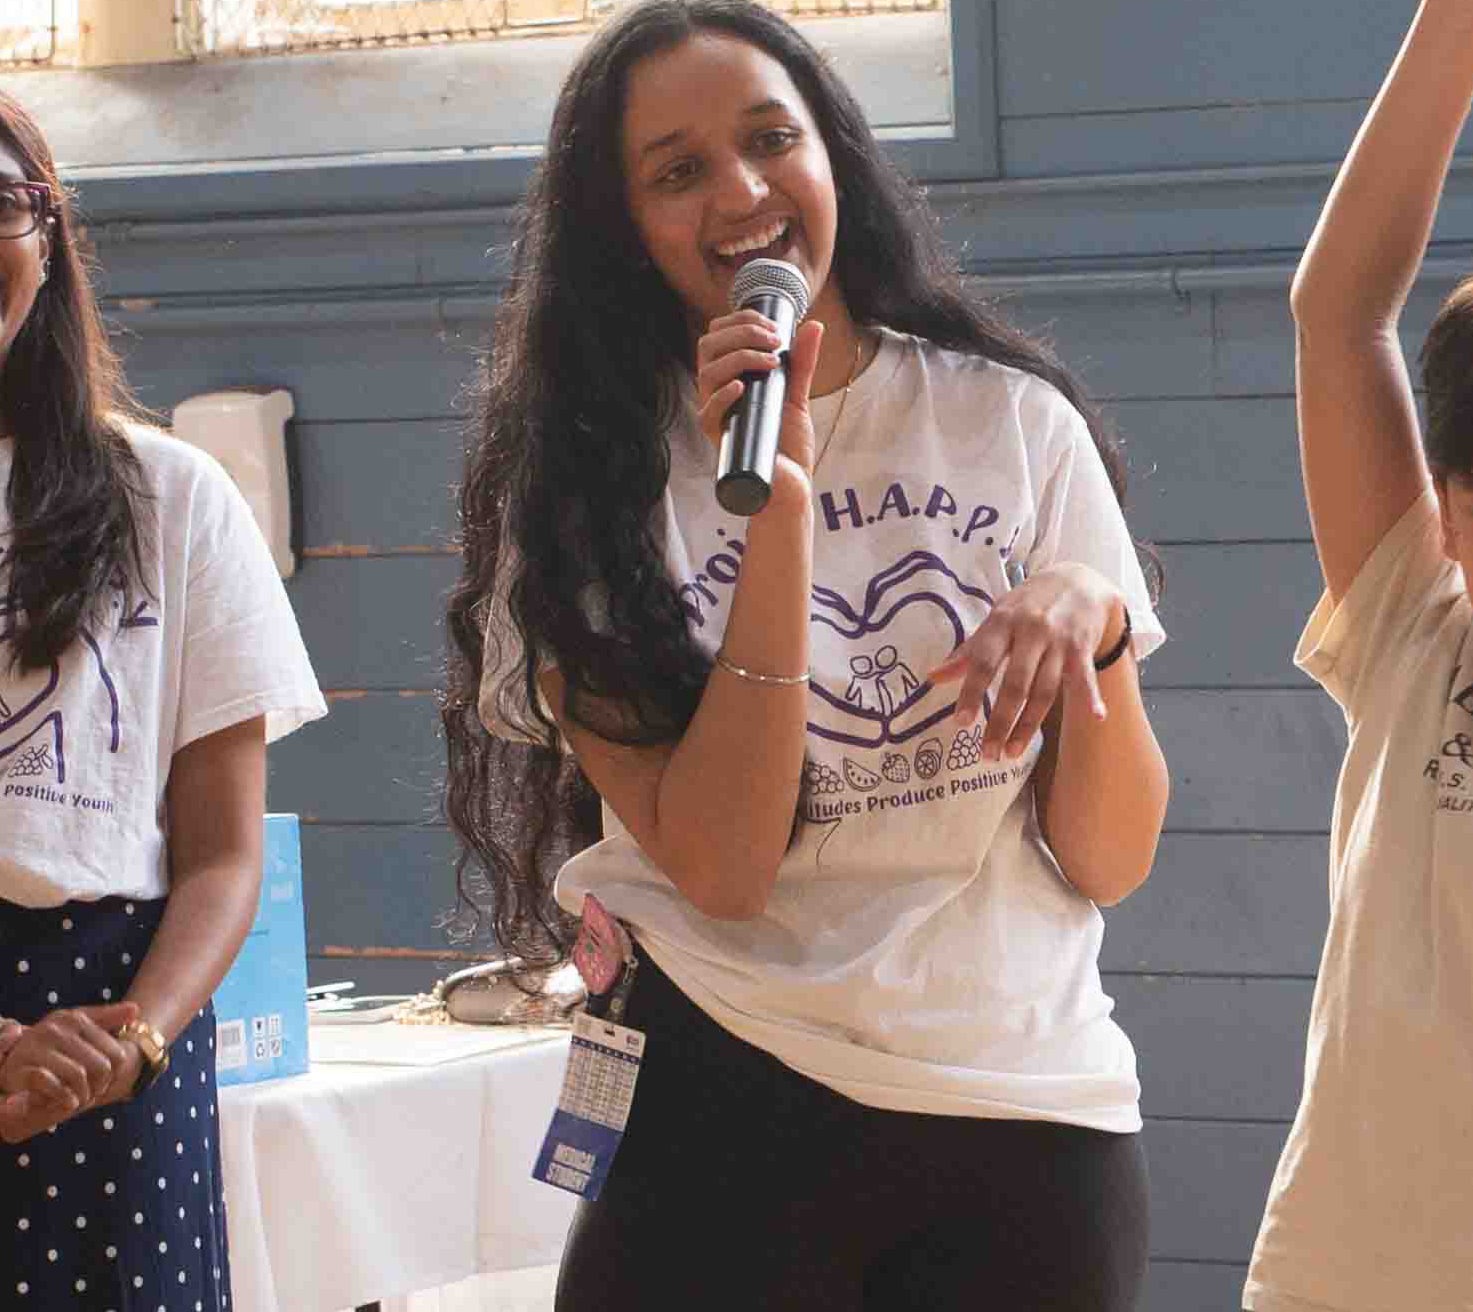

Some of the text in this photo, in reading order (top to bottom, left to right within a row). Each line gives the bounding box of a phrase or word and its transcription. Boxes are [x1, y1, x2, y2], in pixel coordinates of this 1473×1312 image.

[806, 771, 1008, 818] itudes Produce Positive
